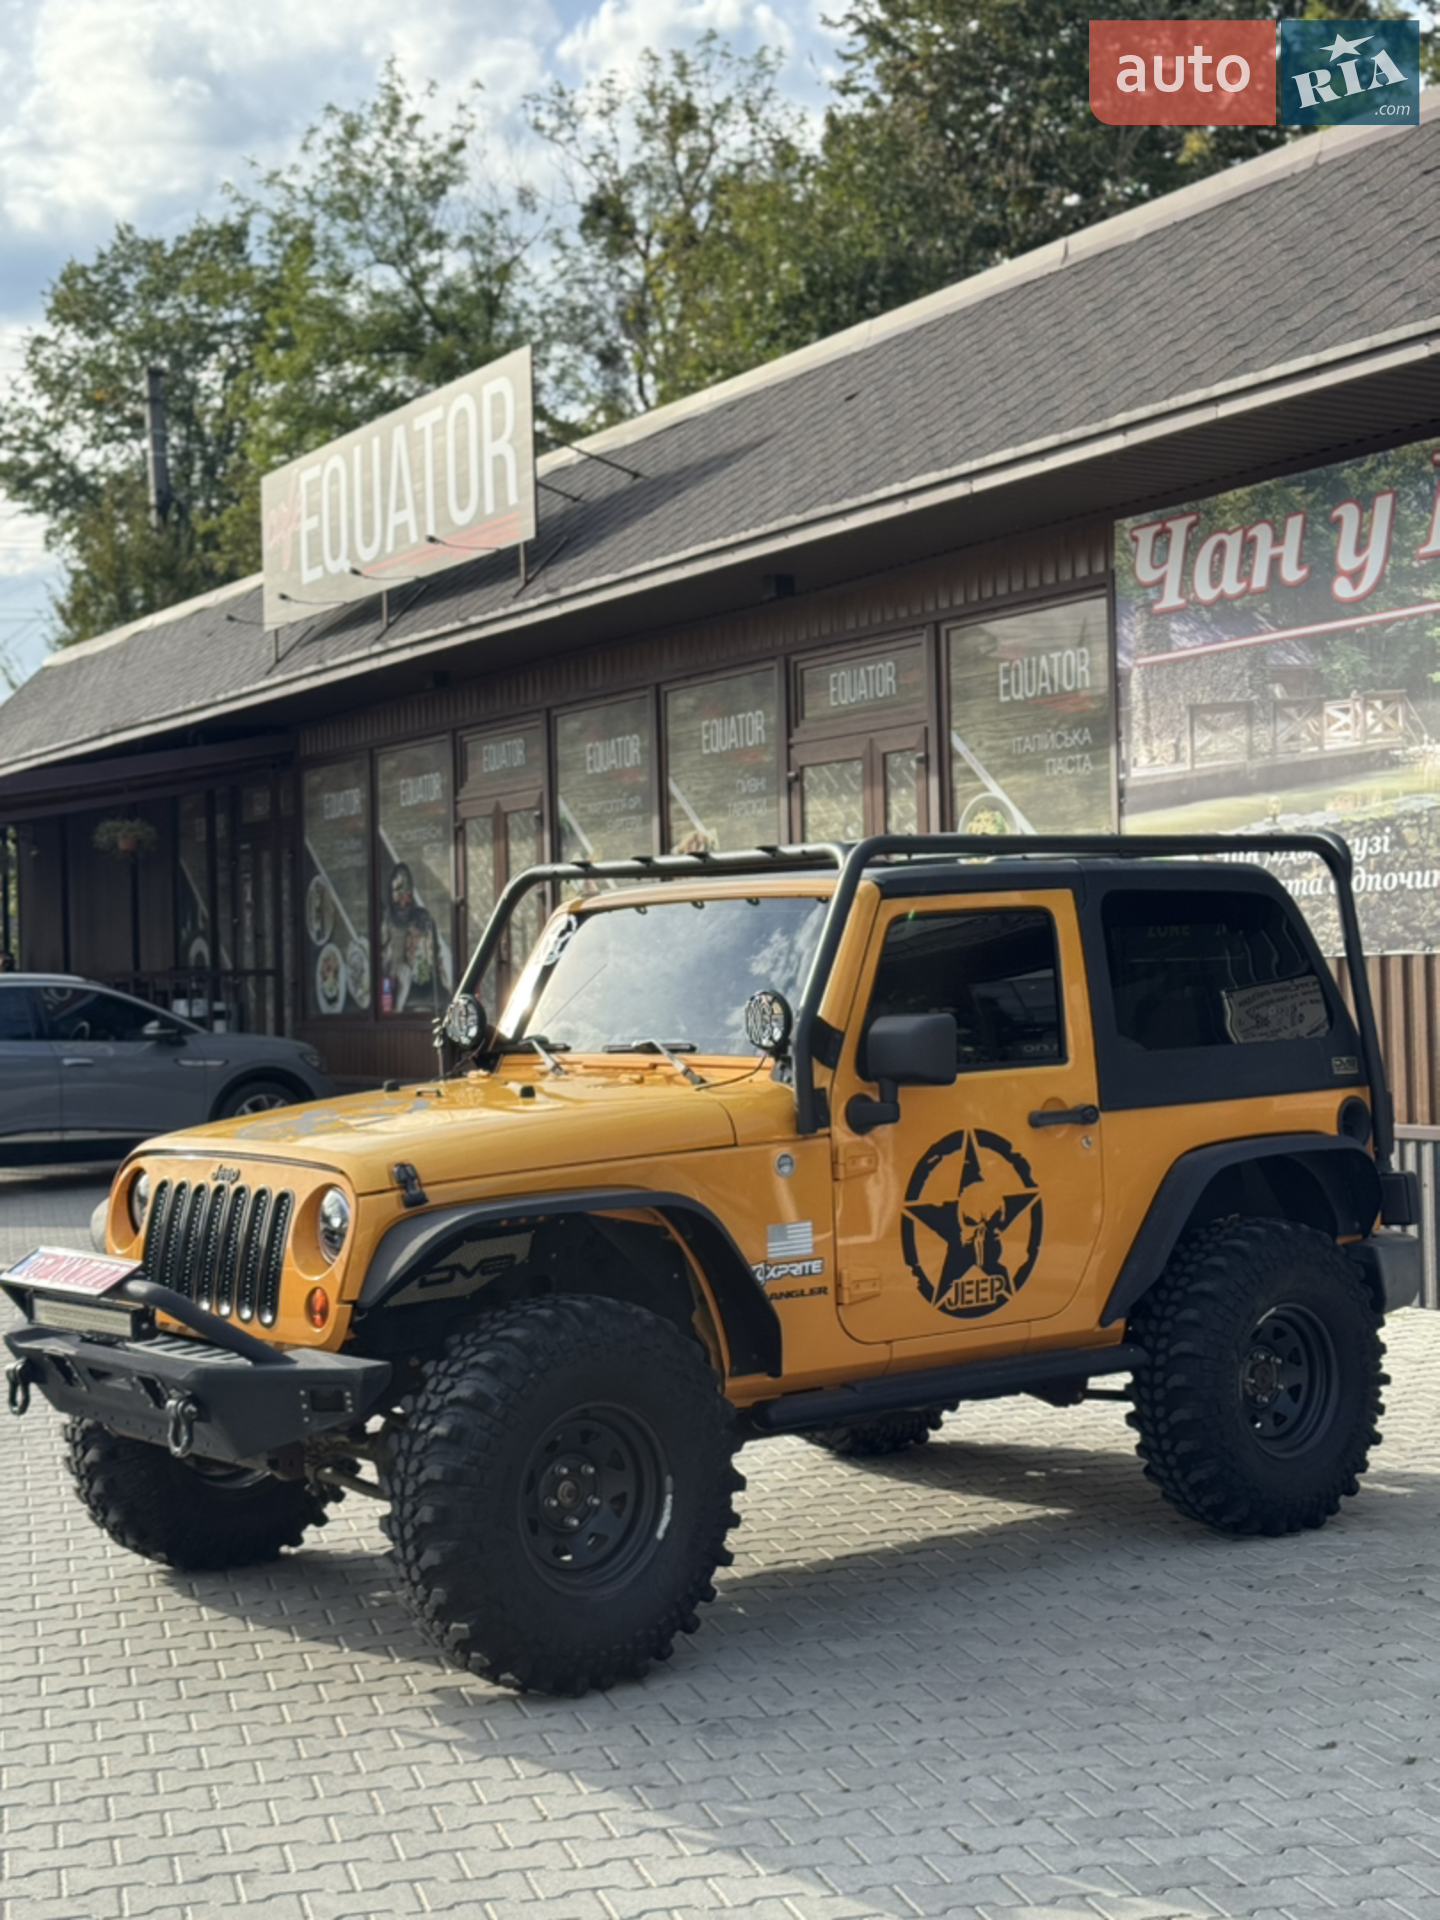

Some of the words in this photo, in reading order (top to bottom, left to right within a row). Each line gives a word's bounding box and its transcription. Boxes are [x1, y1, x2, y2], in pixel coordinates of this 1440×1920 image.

[300, 376, 519, 585] EQUATOR
[1132, 512, 1309, 613] Чан
[1331, 490, 1395, 601] у
[829, 661, 896, 706] EQUATOR
[998, 646, 1090, 702] EQUATOR
[702, 710, 765, 754] EQUATOR
[483, 738, 526, 773] EQUATOR
[586, 734, 641, 774] EQUATOR
[400, 772, 442, 806] EQUATOR
[768, 1286, 829, 1300] ANGLER
[945, 1276, 1006, 1310] JEEP
